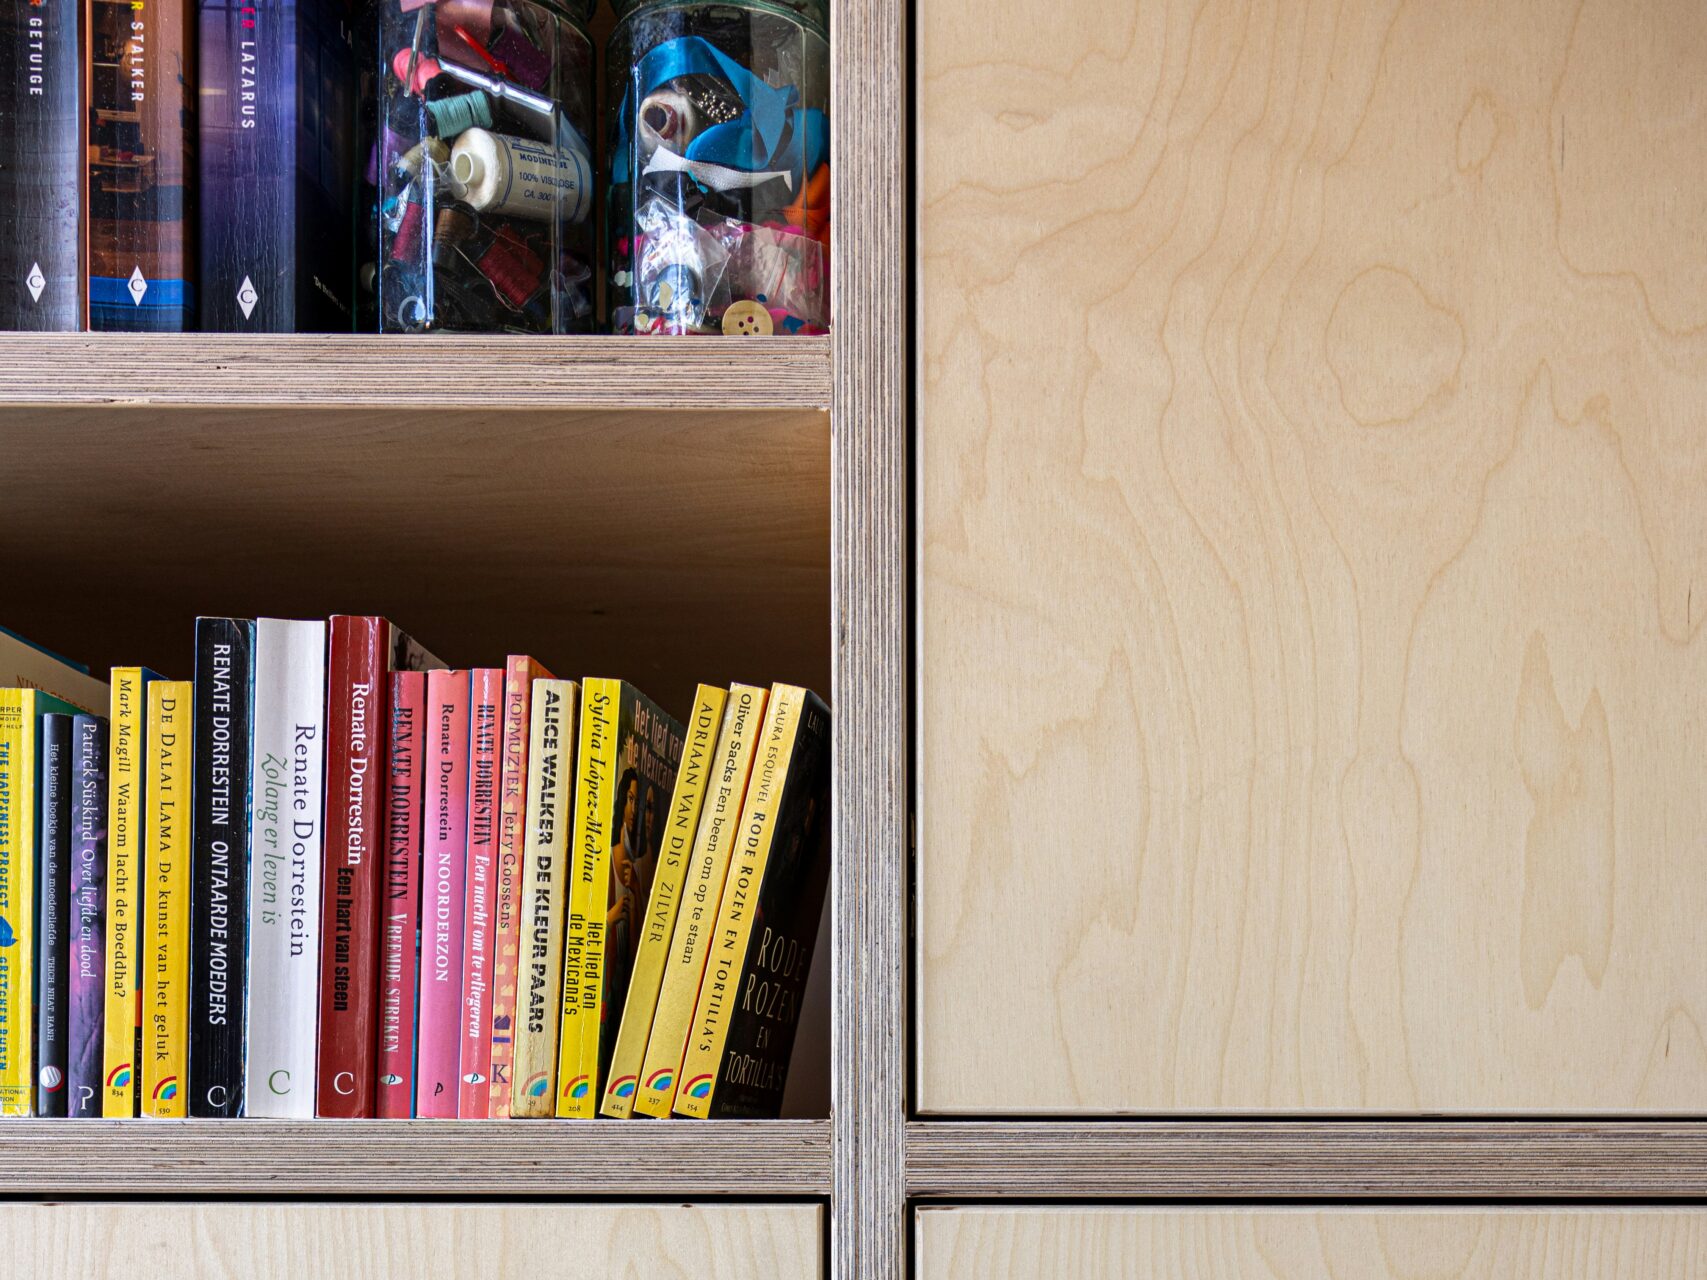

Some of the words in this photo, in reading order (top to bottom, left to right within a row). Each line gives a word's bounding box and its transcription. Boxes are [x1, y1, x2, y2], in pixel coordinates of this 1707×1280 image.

[29, 18, 43, 96] GETUIGE
[131, 21, 144, 102] STALKER
[241, 41, 255, 129] LAZARUS
[519, 172, 538, 183] 100%
[119, 679, 132, 717] Mark
[213, 644, 230, 712] RENATE
[161, 698, 176, 723] DE
[351, 682, 370, 751] Renate
[441, 704, 455, 754] Renate
[476, 704, 495, 754] RENATE
[544, 690, 560, 749] ALICE
[589, 693, 611, 749] Sylvia
[634, 699, 650, 740] Het
[651, 713, 668, 751] lied
[734, 693, 752, 738] Oliver
[771, 701, 788, 741] LAURA
[0, 742, 9, 766] THE
[50, 744, 59, 762] Het
[82, 723, 98, 776] Patrick
[115, 724, 131, 772] Magill
[160, 734, 175, 791] DALAI
[392, 707, 413, 778] RENATE
[506, 693, 523, 797] POPMUZIEK
[627, 734, 639, 768] de
[686, 703, 713, 786] ADRIAAN
[723, 741, 742, 783] Sacks
[49, 766, 59, 798] kleine
[212, 717, 229, 825] DORRESTEIN
[256, 753, 288, 824] Zolang
[294, 724, 316, 810] Renate
[758, 747, 778, 804] ESQUIVEL
[0, 773, 9, 845] HAPPINESS
[48, 802, 58, 835] boekje
[82, 781, 97, 840] Süskind
[117, 783, 129, 847] Waarom
[347, 757, 367, 866] Dorrestein
[439, 761, 453, 840] Dorrestein
[473, 760, 493, 845] DORRESTEIN
[538, 754, 558, 845] WALKER
[582, 757, 606, 883] López-Medina
[675, 794, 696, 829] VAN
[715, 785, 731, 814] Een
[49, 839, 57, 858] van
[159, 801, 175, 851] LAMA
[264, 829, 279, 848] er
[388, 785, 410, 900] DORRESTEIN
[501, 811, 518, 849] Jerry
[705, 817, 725, 852] been
[744, 812, 766, 857] RODE
[49, 862, 58, 874] de
[81, 849, 94, 883] Over
[116, 854, 128, 893] lacht
[158, 862, 171, 883] De
[474, 855, 490, 882] Een
[536, 857, 552, 882] DE
[666, 839, 685, 868] DIS
[701, 856, 715, 880] om
[0, 851, 9, 908] PROJECT
[210, 841, 229, 938] ONTAARDE
[263, 854, 286, 904] leven
[290, 819, 314, 958] Dorrestein
[337, 868, 354, 896] Een
[500, 853, 516, 929] Goossens
[693, 884, 707, 902] op
[730, 867, 753, 921] ROZEN
[48, 878, 58, 946] moederliefde
[77, 887, 97, 922] liefde
[115, 900, 127, 917] de
[158, 891, 171, 937] kunst
[263, 911, 281, 925] is
[336, 900, 353, 932] hart
[436, 853, 450, 981] NOORDERZON
[472, 886, 488, 925] nacht
[532, 890, 551, 958] KLEUR
[571, 913, 586, 929] de
[648, 881, 674, 943] ZILVER
[692, 905, 704, 921] te
[81, 926, 92, 941] en
[335, 935, 349, 962] van
[385, 913, 408, 982] VREEMDE
[472, 930, 484, 951] om
[587, 922, 603, 946] Het
[682, 924, 698, 964] staan
[722, 929, 737, 950] EN
[758, 927, 806, 982] RODE
[47, 957, 55, 983] THICH
[81, 945, 96, 978] dood
[114, 923, 127, 997] Boeddha?
[158, 945, 168, 972] van
[472, 955, 486, 968] te
[564, 937, 583, 1015] Mexicana's
[584, 952, 601, 978] lied
[47, 988, 55, 1012] NHAT
[157, 981, 170, 1007] het
[209, 942, 227, 1025] MOEDERS
[334, 967, 350, 1011] steen
[467, 972, 487, 1038] vliegeren
[528, 964, 546, 1033] PAARS
[583, 985, 597, 1009] van
[699, 960, 731, 1052] TORTILLA'S
[742, 973, 799, 1024] ROZEN
[47, 1015, 55, 1041] HANH
[154, 1015, 169, 1061] geluk
[383, 988, 401, 1052] STREKEN
[756, 1026, 768, 1049] EN
